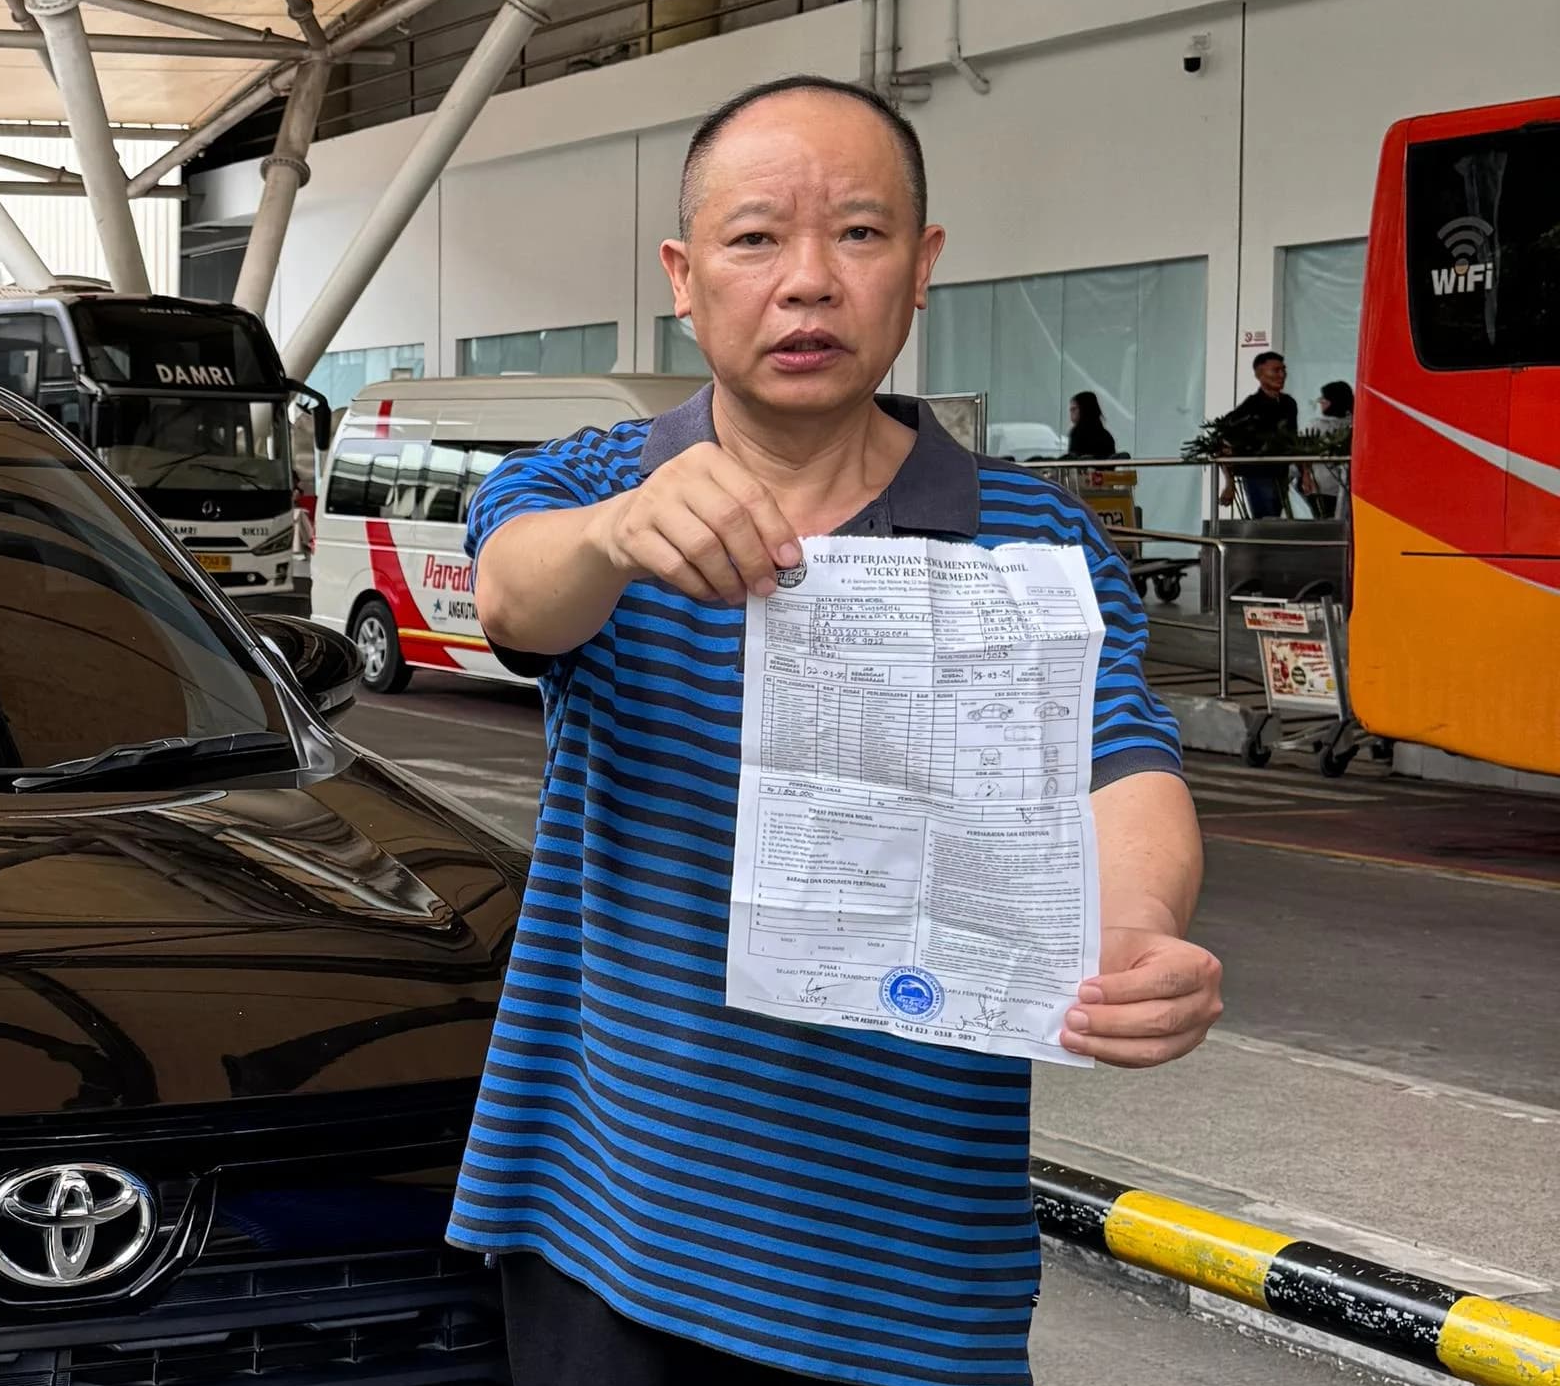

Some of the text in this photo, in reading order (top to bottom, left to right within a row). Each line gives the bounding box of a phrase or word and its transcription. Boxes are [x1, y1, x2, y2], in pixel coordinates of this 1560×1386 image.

[1431, 261, 1494, 295] WiFi
[155, 363, 235, 386] DAMRI
[172, 526, 198, 535] AMRI
[813, 554, 850, 564] SURAT
[853, 555, 921, 564] PERJANJIAN
[865, 567, 899, 577] VICKY
[948, 572, 988, 581] MEDAN
